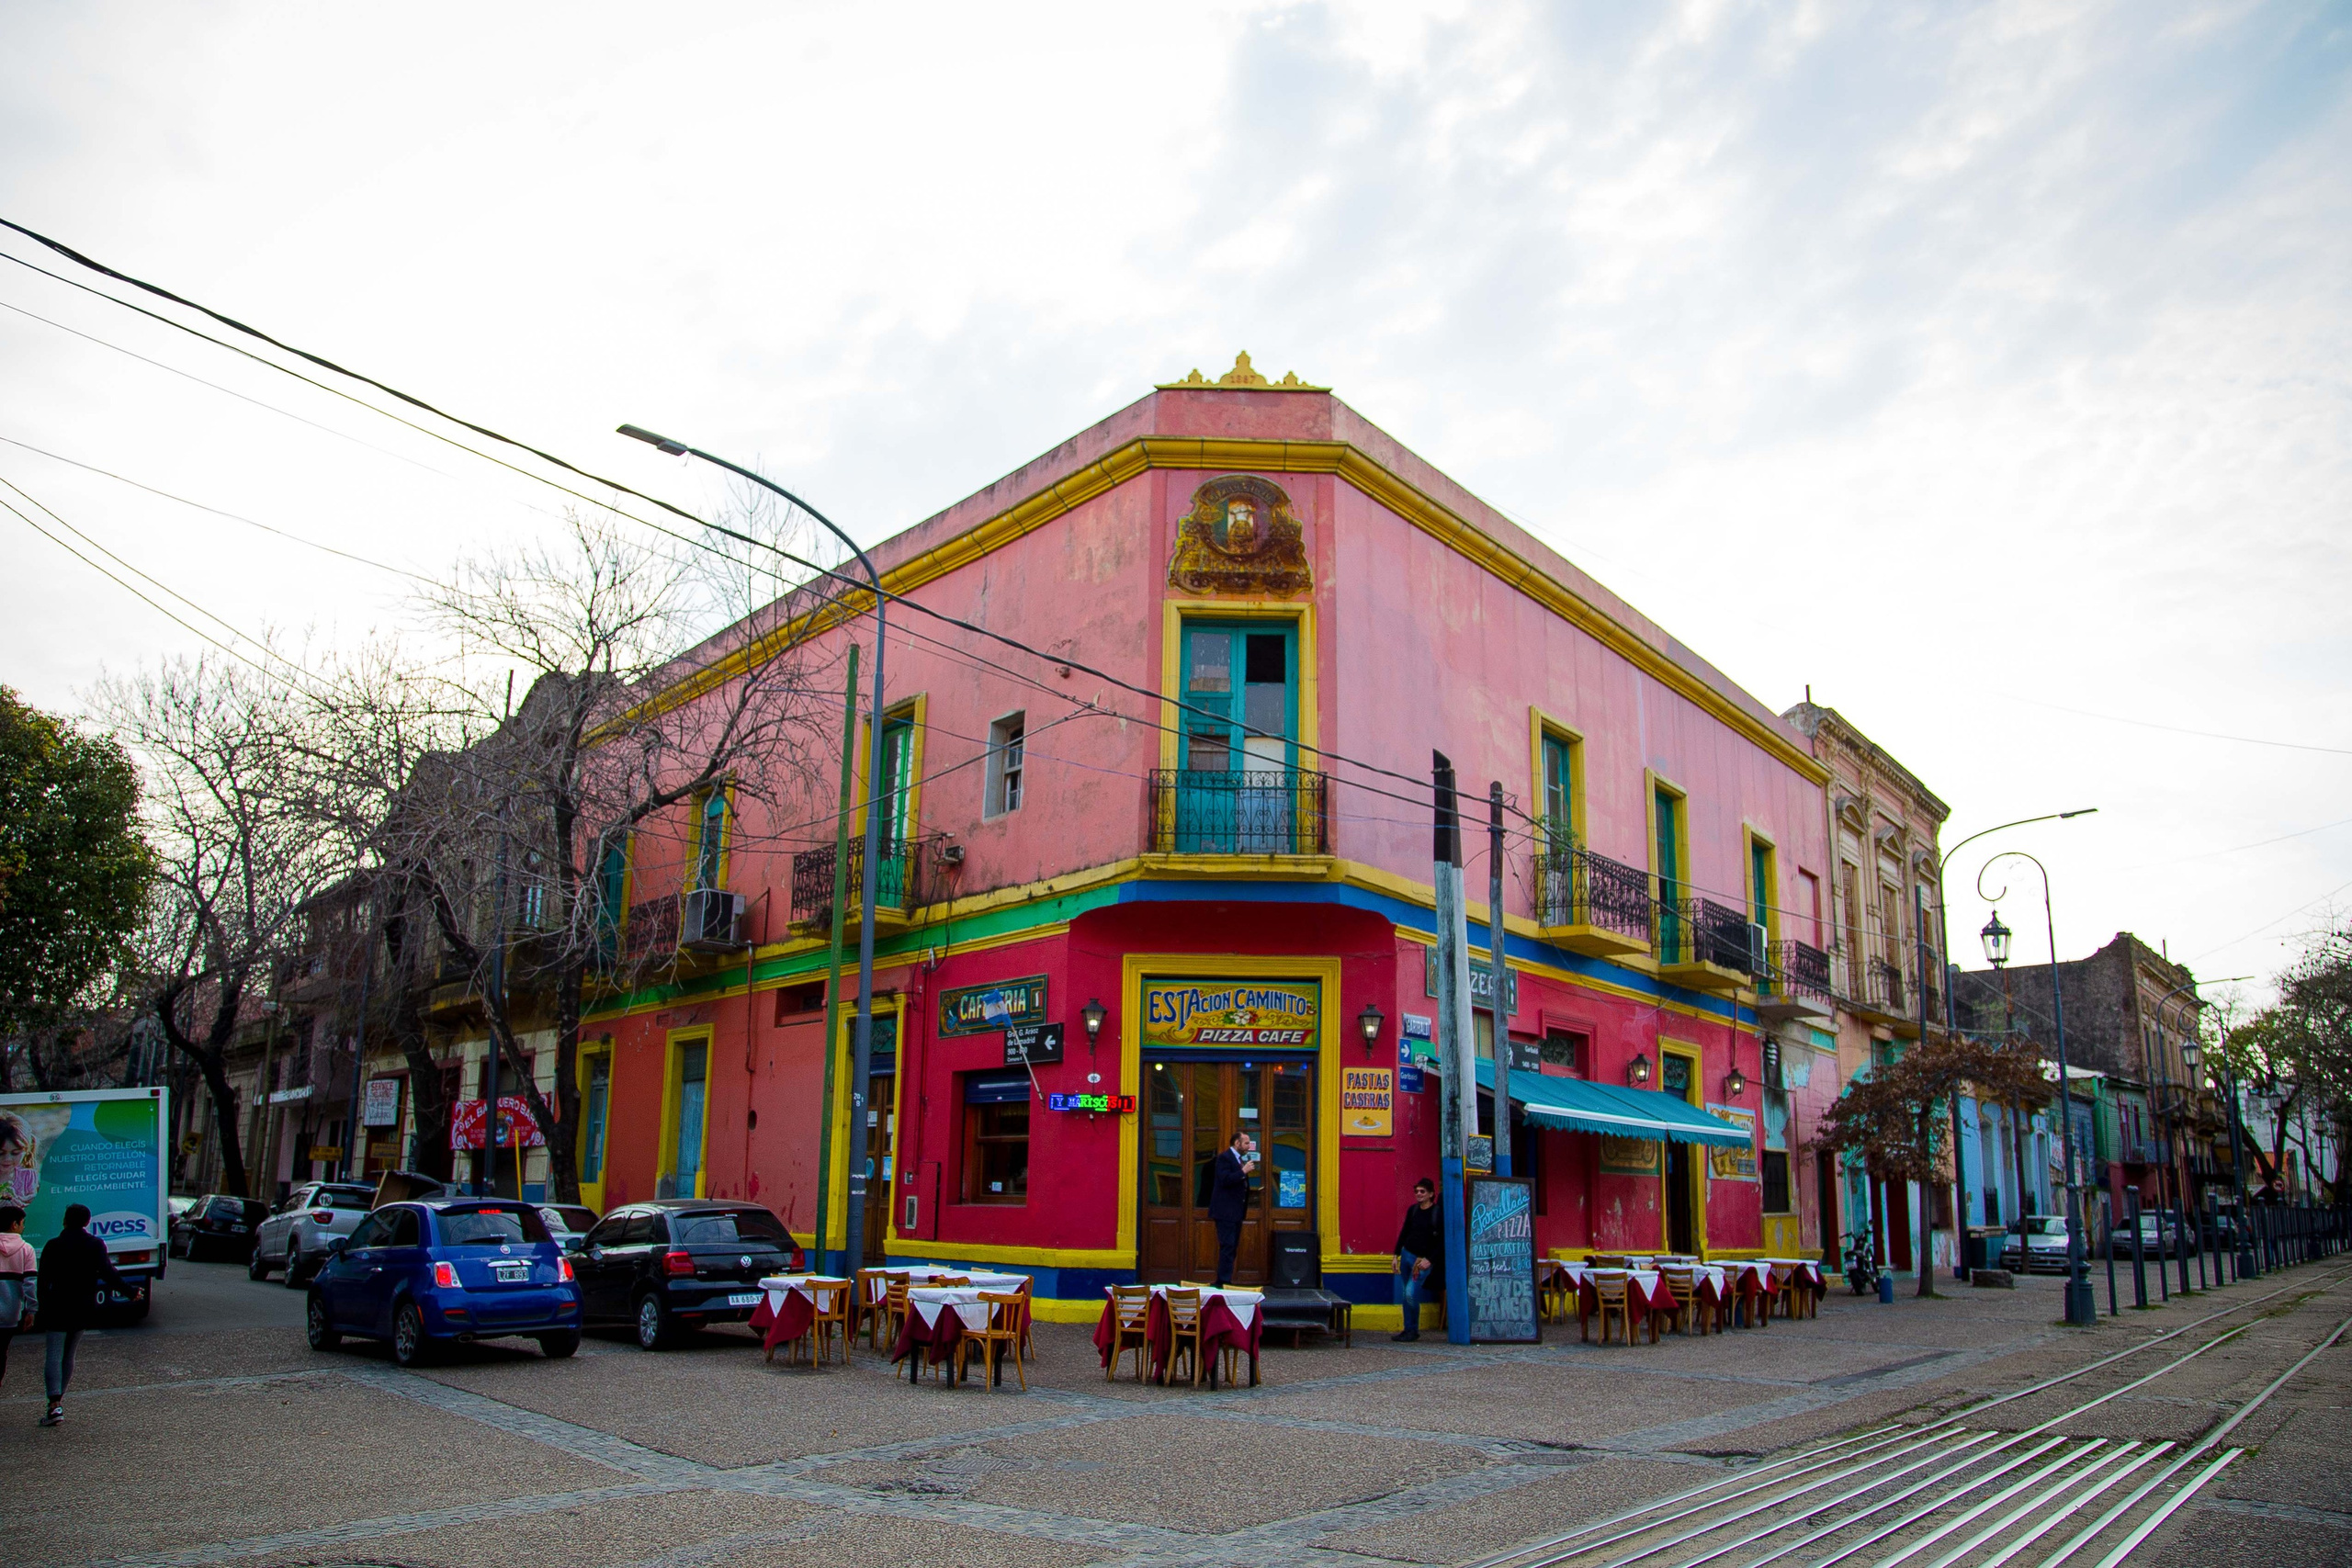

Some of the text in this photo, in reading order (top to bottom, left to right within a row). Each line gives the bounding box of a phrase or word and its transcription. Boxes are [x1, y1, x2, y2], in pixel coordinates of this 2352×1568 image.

[1234, 988, 1306, 1016] CAMINITO
[1199, 1029, 1305, 1043] PIZZA CAFE
[1347, 1073, 1390, 1089] PASTAS
[1344, 1092, 1390, 1110] CASERAS
[71, 1139, 146, 1152] CUANDO ELEGÍS
[50, 1150, 146, 1163] NUESTRO BOTELLÓN
[85, 1160, 146, 1171] RETORNABLE
[74, 1171, 146, 1182] ELEGÍS CUIDAR
[64, 1181, 148, 1193] MEDIOAMBIENTE.
[1498, 1213, 1532, 1239] PIZZA
[1476, 1297, 1532, 1321] TANGO
